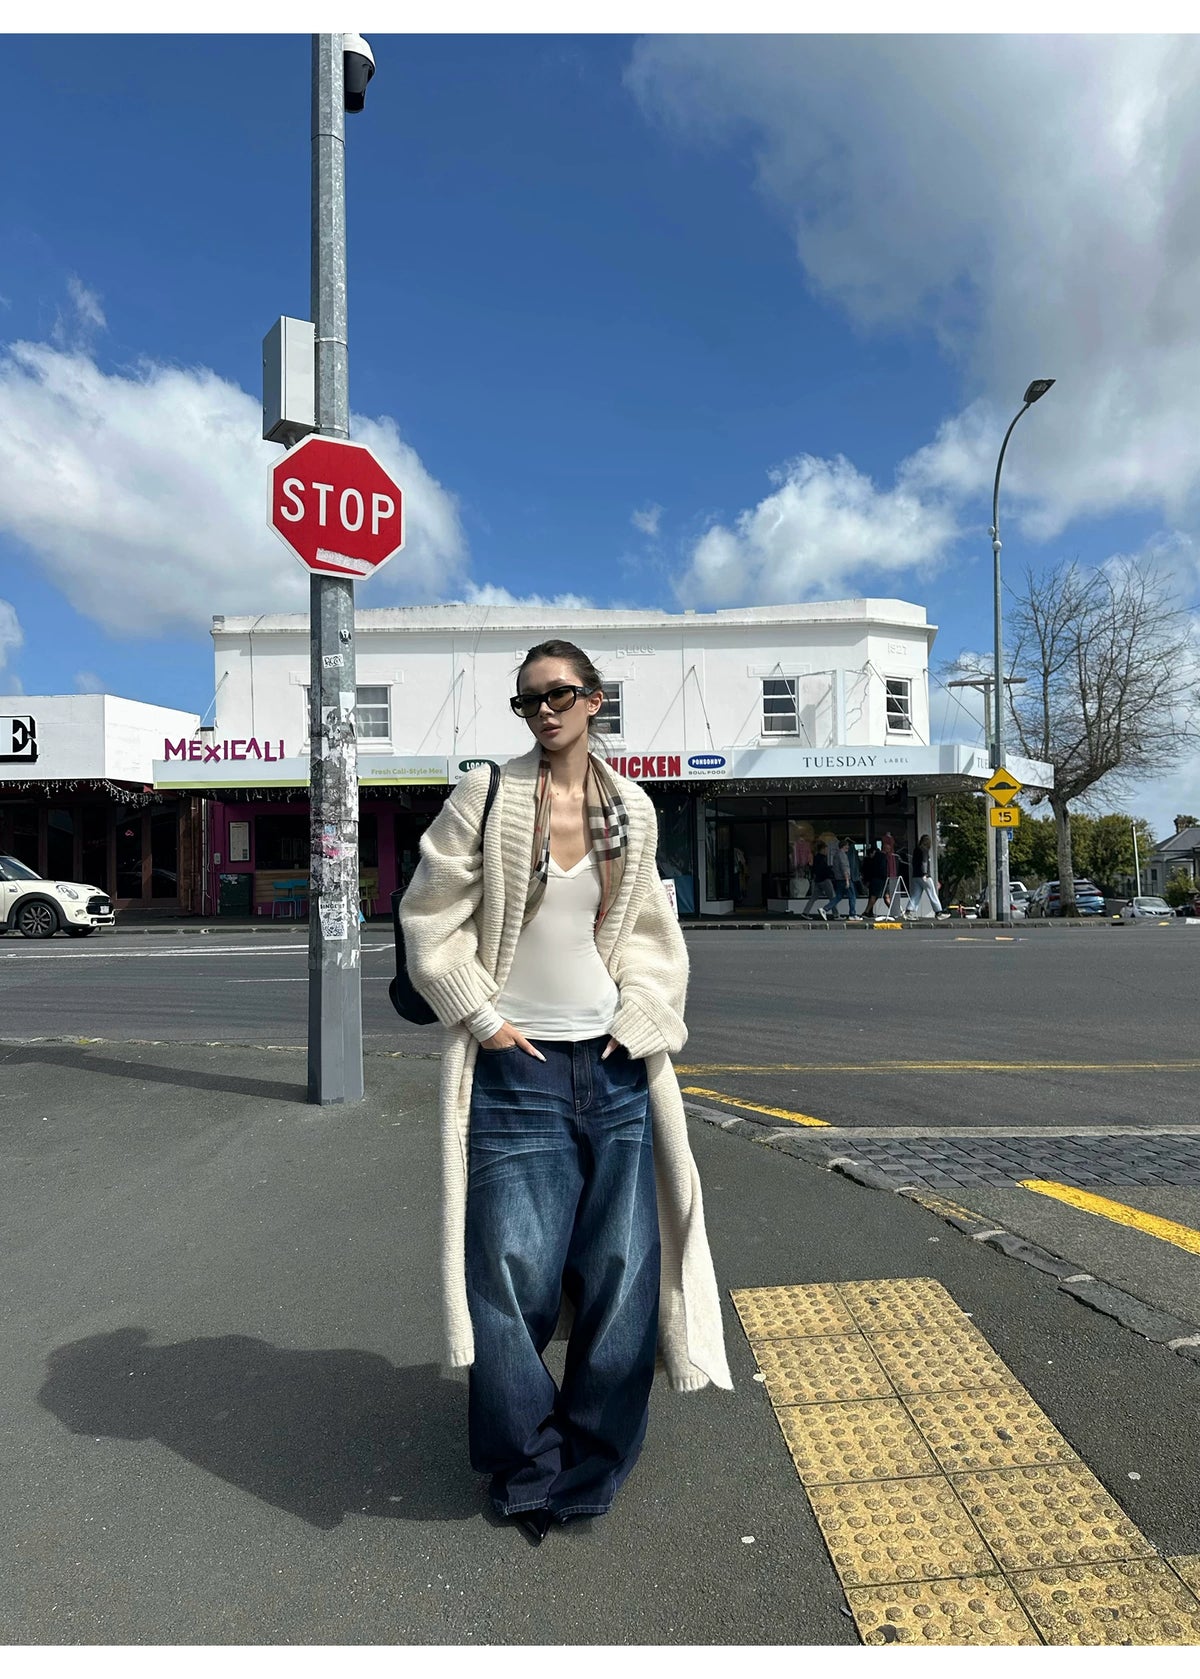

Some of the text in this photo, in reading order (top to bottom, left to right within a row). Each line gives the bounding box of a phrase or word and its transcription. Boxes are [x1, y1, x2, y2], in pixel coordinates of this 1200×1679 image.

[280, 477, 395, 535] STOP
[164, 737, 285, 763] MEXICALI
[691, 758, 722, 766] PONSONBY
[802, 755, 877, 768] TUESDAY
[371, 768, 391, 776] Fresh
[998, 811, 1012, 823] 15
